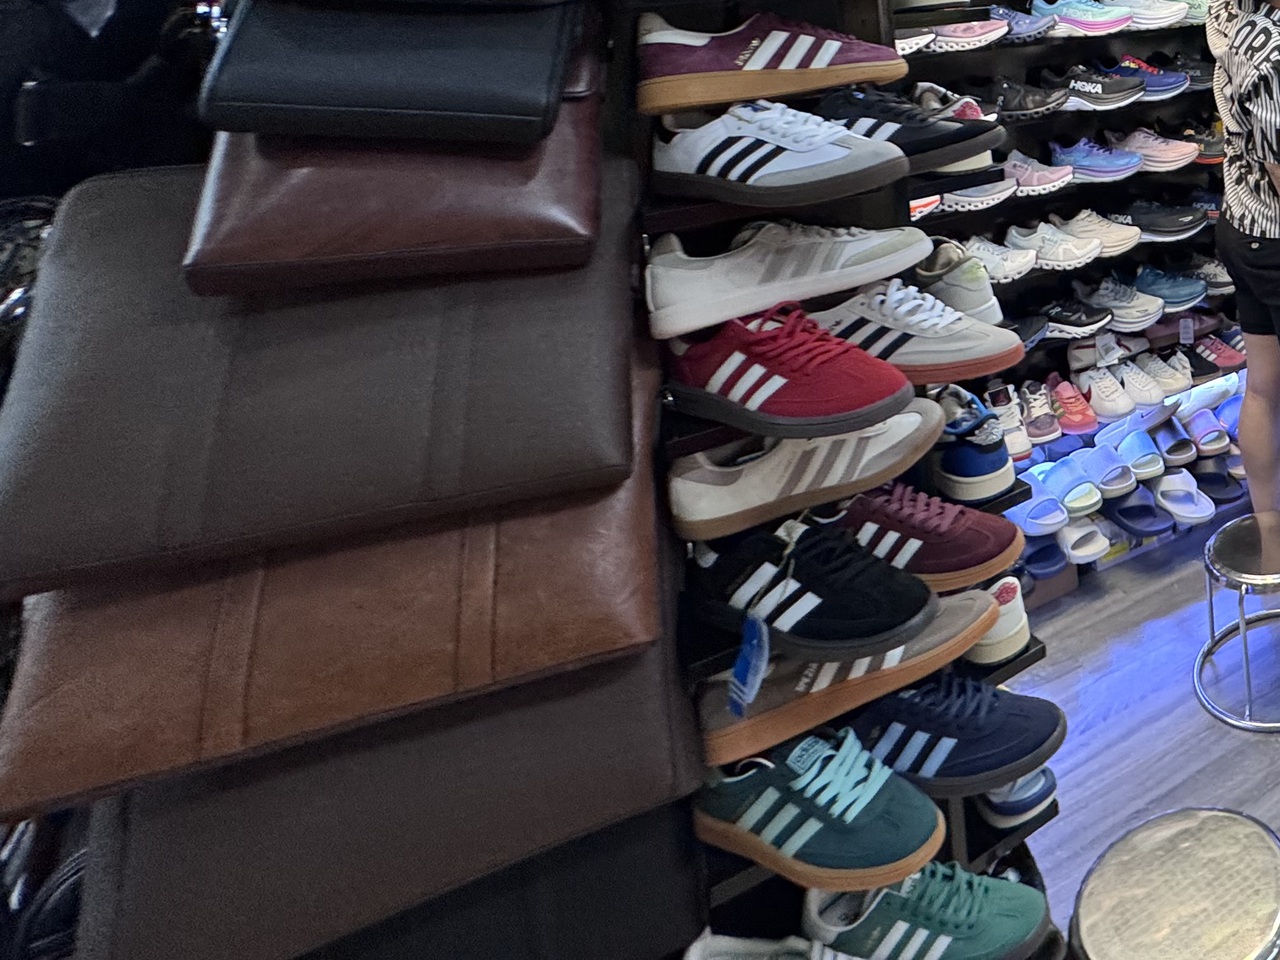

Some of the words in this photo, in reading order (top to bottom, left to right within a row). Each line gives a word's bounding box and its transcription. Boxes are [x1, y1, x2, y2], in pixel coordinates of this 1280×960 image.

[1061, 7, 1093, 20] HOKA
[1069, 79, 1103, 94] HOKA
[1192, 202, 1217, 211] HOKA
